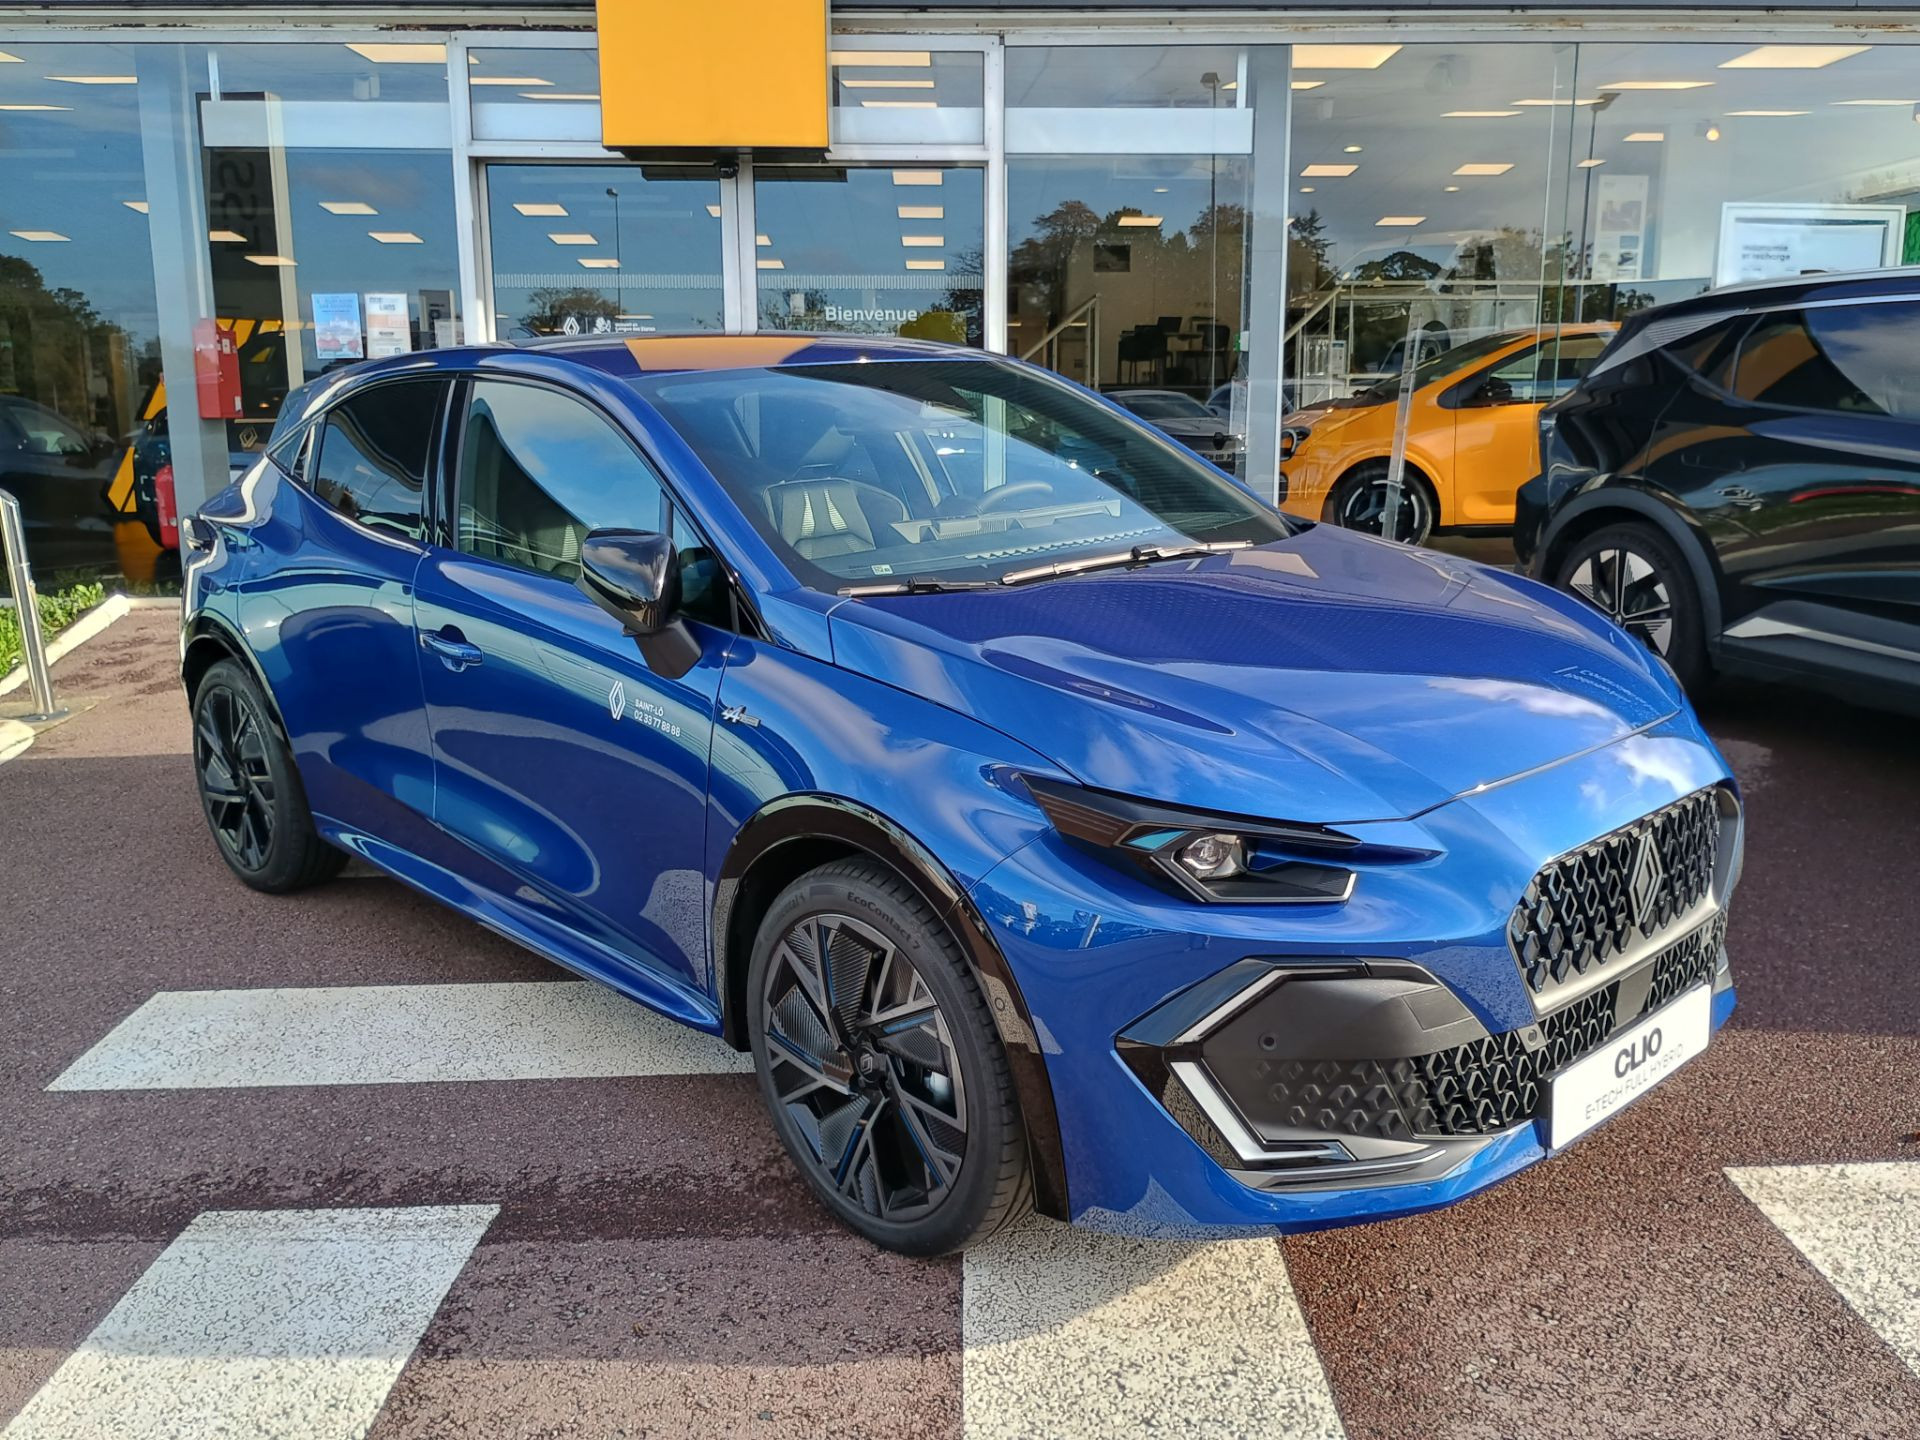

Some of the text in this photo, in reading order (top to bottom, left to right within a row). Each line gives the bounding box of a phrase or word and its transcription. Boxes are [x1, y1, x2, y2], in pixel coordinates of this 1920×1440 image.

[825, 307, 918, 322] Bienvenue
[634, 710, 643, 722] 02
[643, 714, 653, 725] 33
[653, 717, 661, 728] 77
[671, 725, 681, 737] 88
[635, 699, 664, 717] SAINT-LÔ
[847, 891, 911, 942] EcoContact
[1614, 1027, 1662, 1078] CLIO
[1585, 1043, 1684, 1120] E-TECH FULL HYBRID
